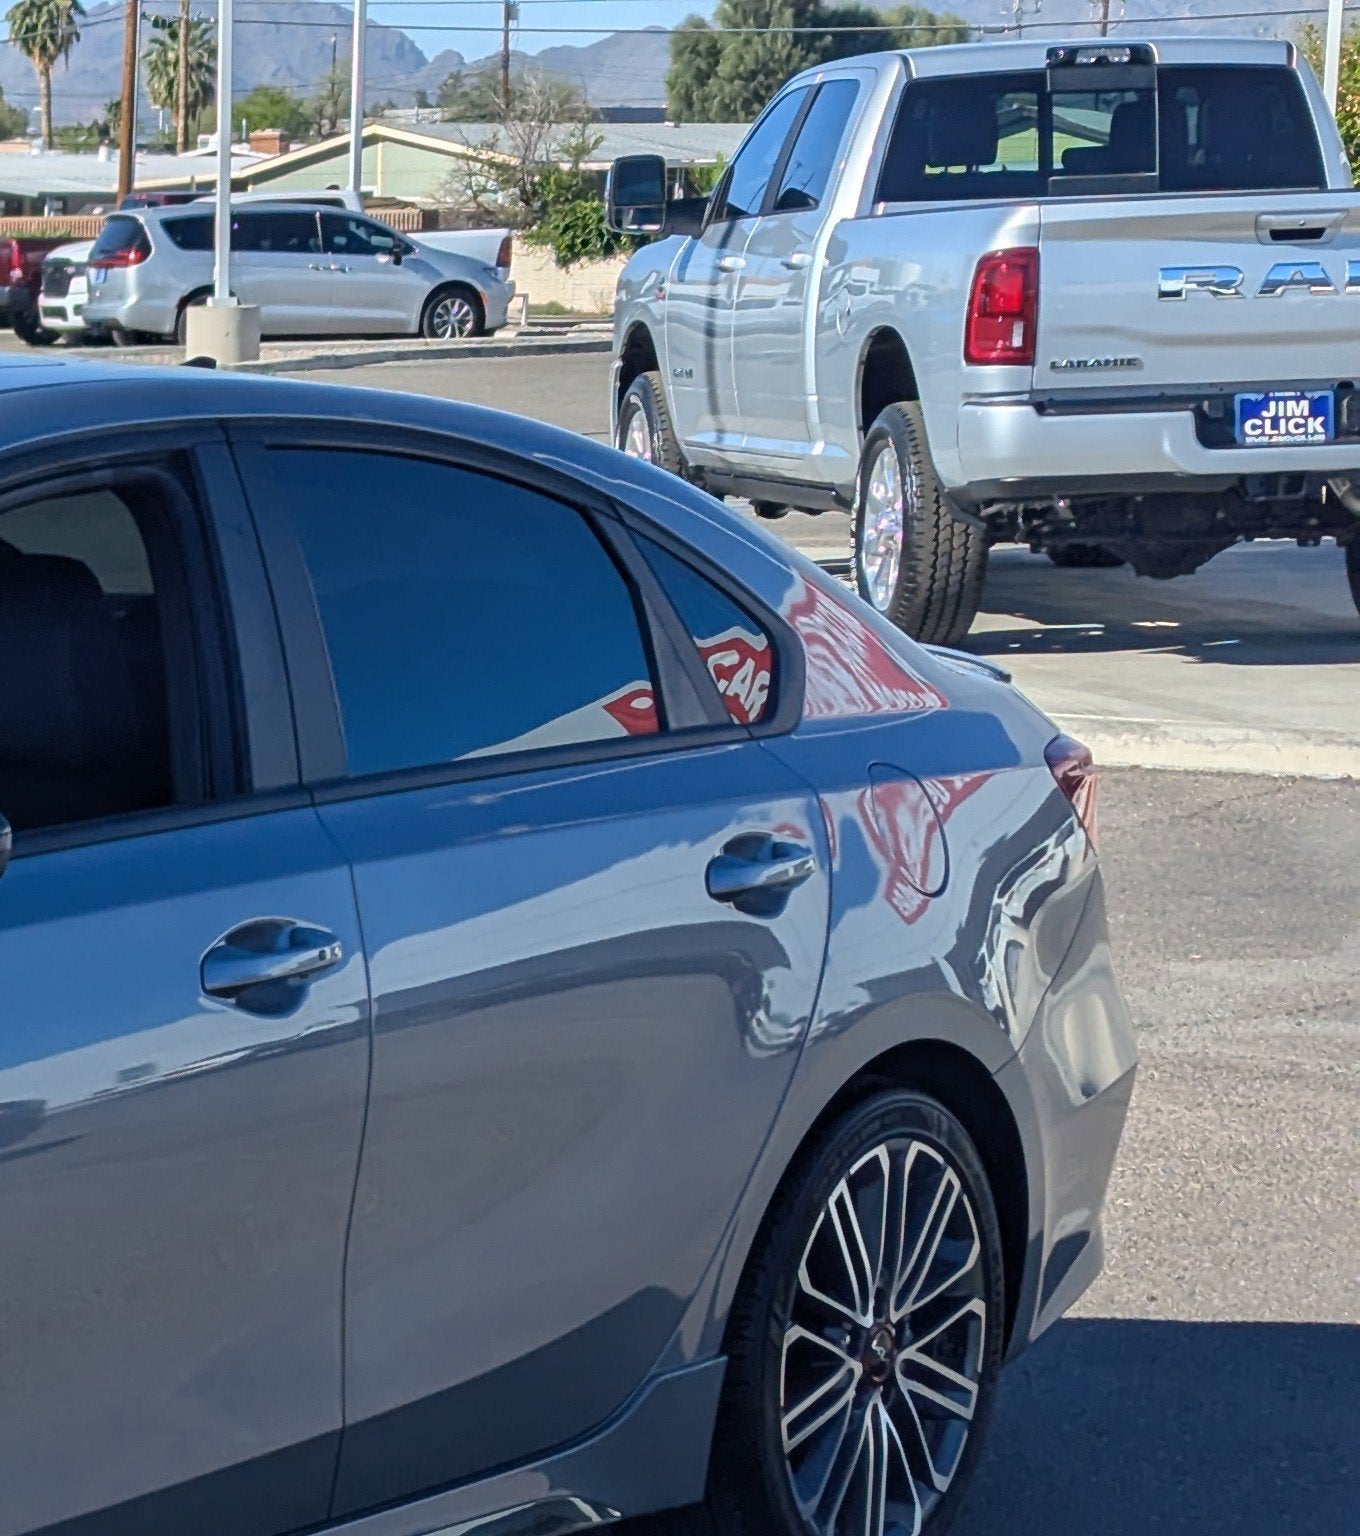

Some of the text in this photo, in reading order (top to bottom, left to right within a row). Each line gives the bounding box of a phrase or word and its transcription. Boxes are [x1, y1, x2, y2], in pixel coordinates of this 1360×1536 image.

[1157, 260, 1360, 302] RA
[1049, 357, 1139, 371] LARAMIE
[1261, 400, 1310, 417] JIM
[1244, 416, 1326, 435] CLICK
